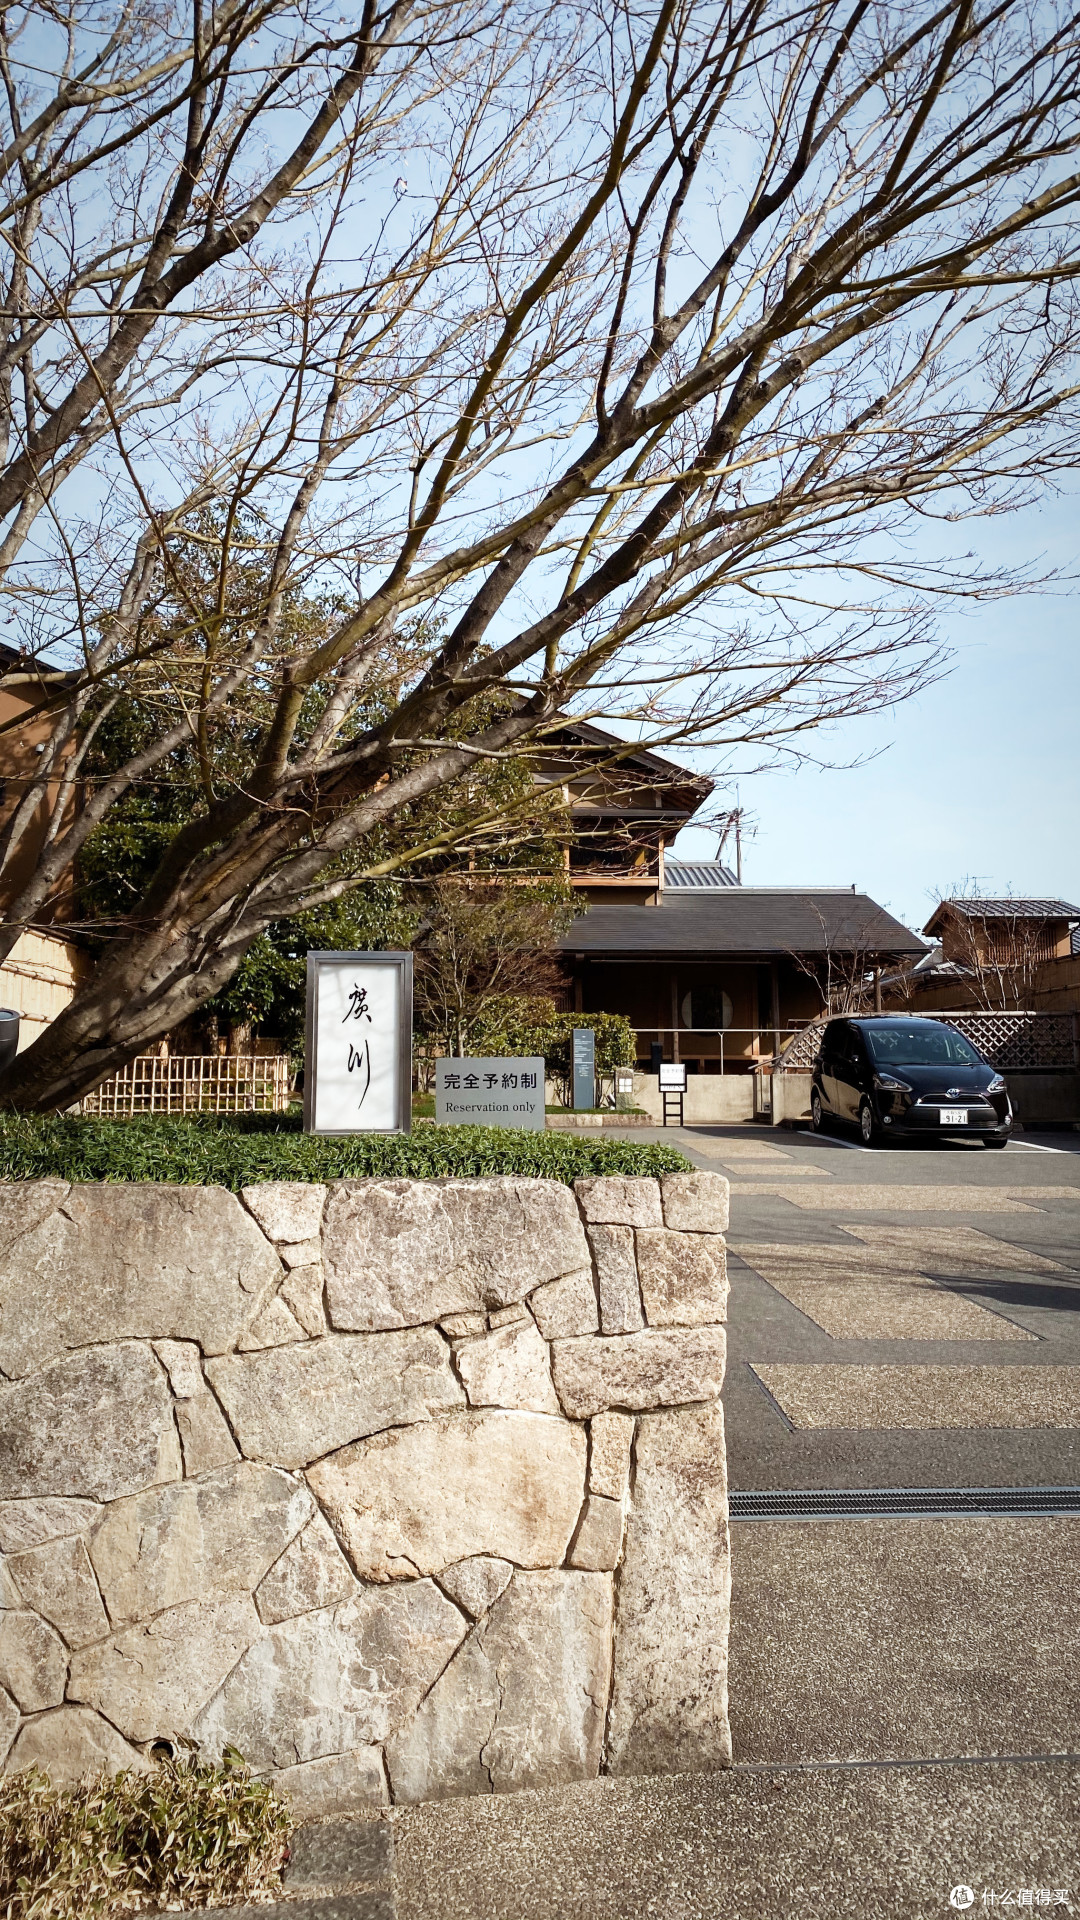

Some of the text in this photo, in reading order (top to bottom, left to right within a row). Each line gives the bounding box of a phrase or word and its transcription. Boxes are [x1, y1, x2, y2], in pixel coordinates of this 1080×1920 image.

[444, 1073, 537, 1089] 完全予約制
[445, 1102, 536, 1114] Reservation only
